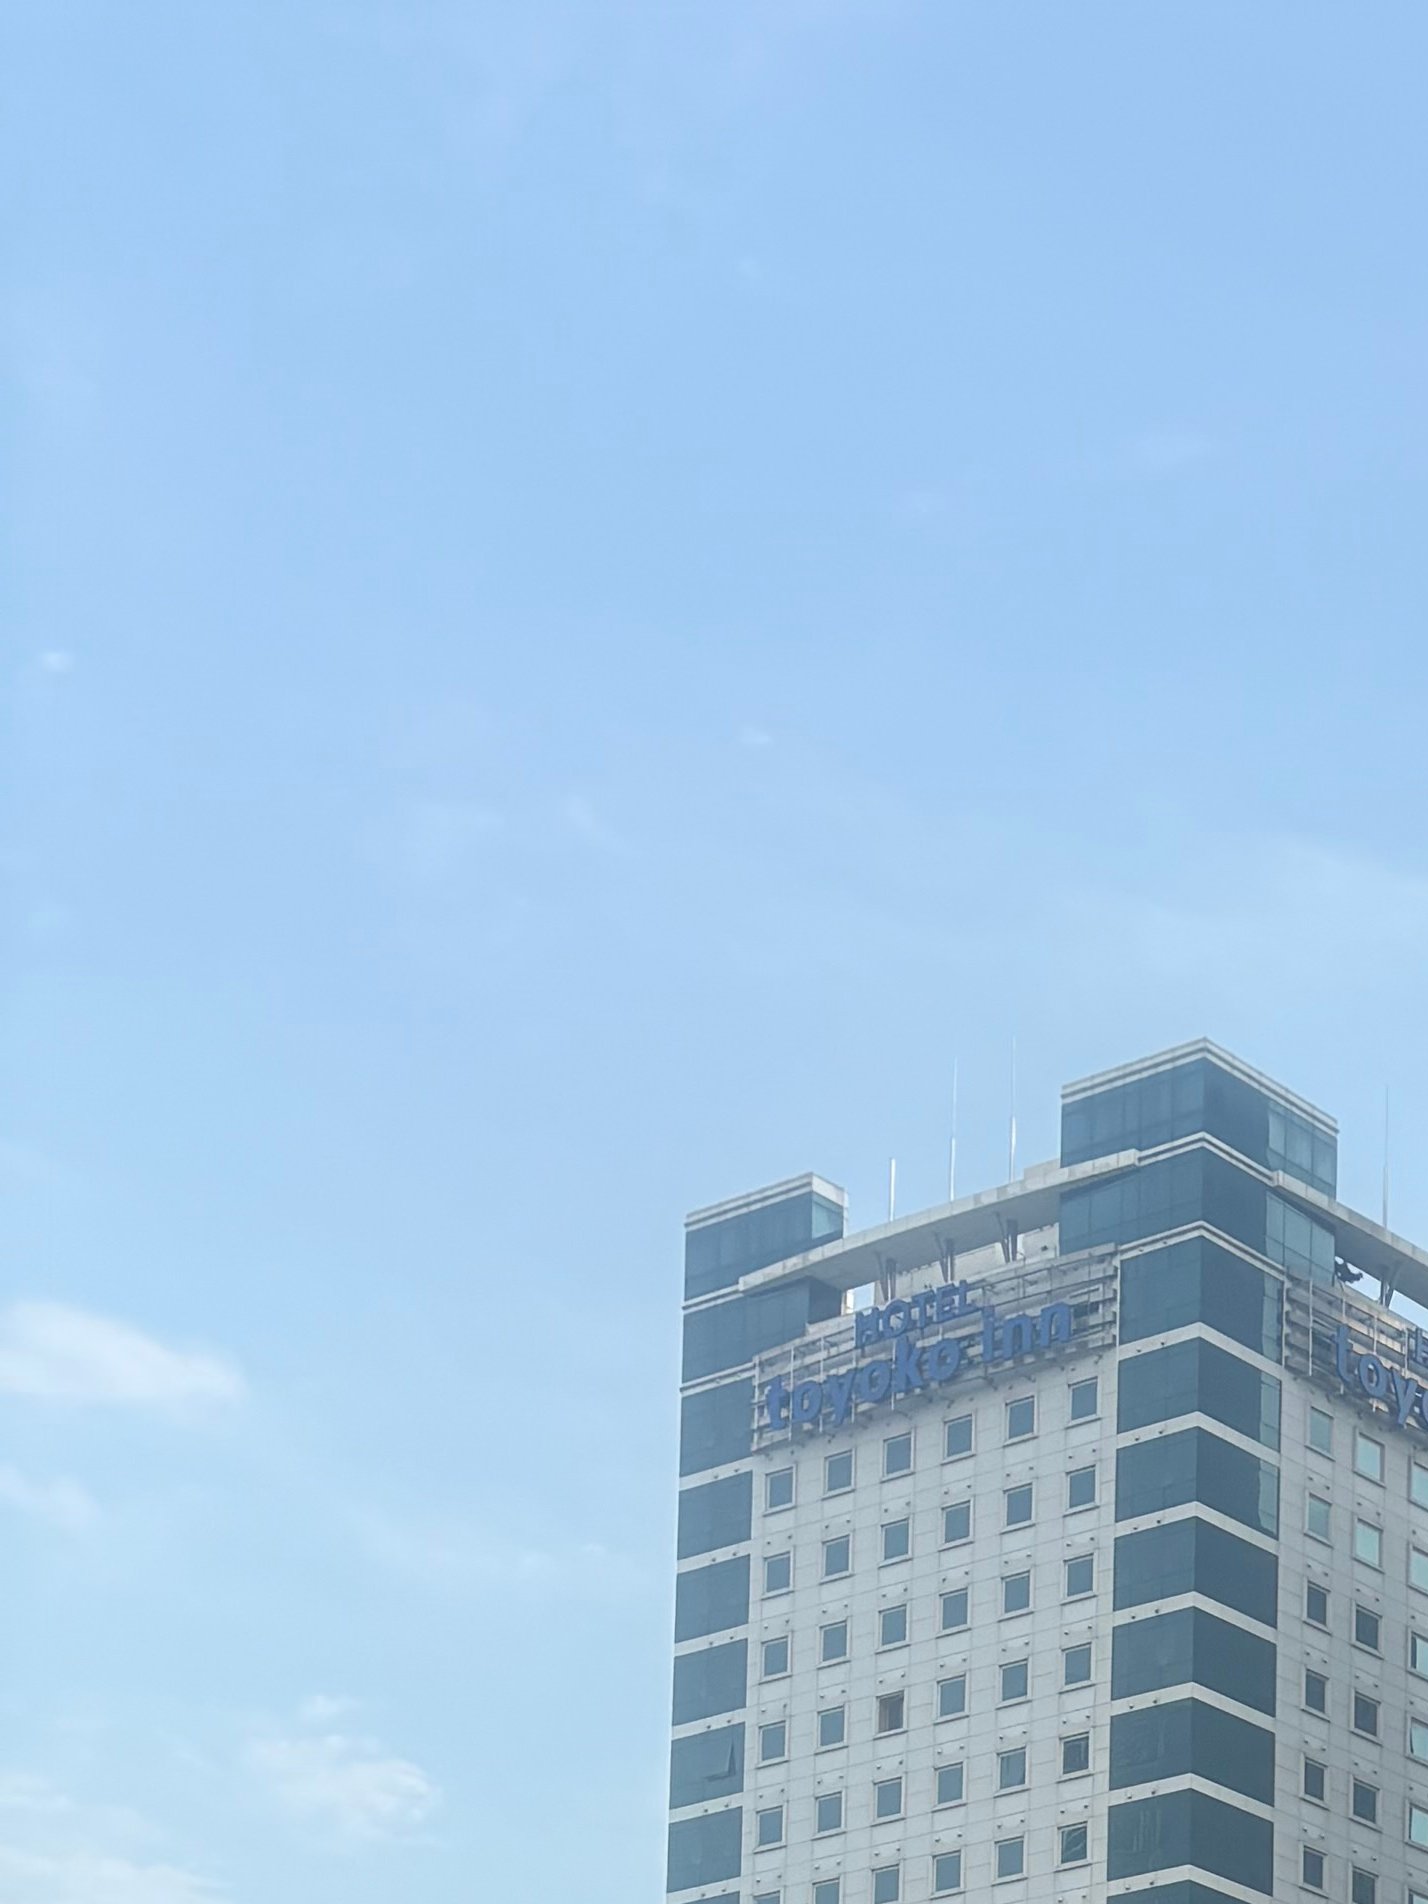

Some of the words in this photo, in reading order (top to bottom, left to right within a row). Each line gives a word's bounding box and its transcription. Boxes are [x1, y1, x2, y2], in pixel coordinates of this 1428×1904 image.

[855, 1280, 976, 1347] HOTEL
[766, 1333, 961, 1430] toyoko
[982, 1301, 1073, 1363] inn
